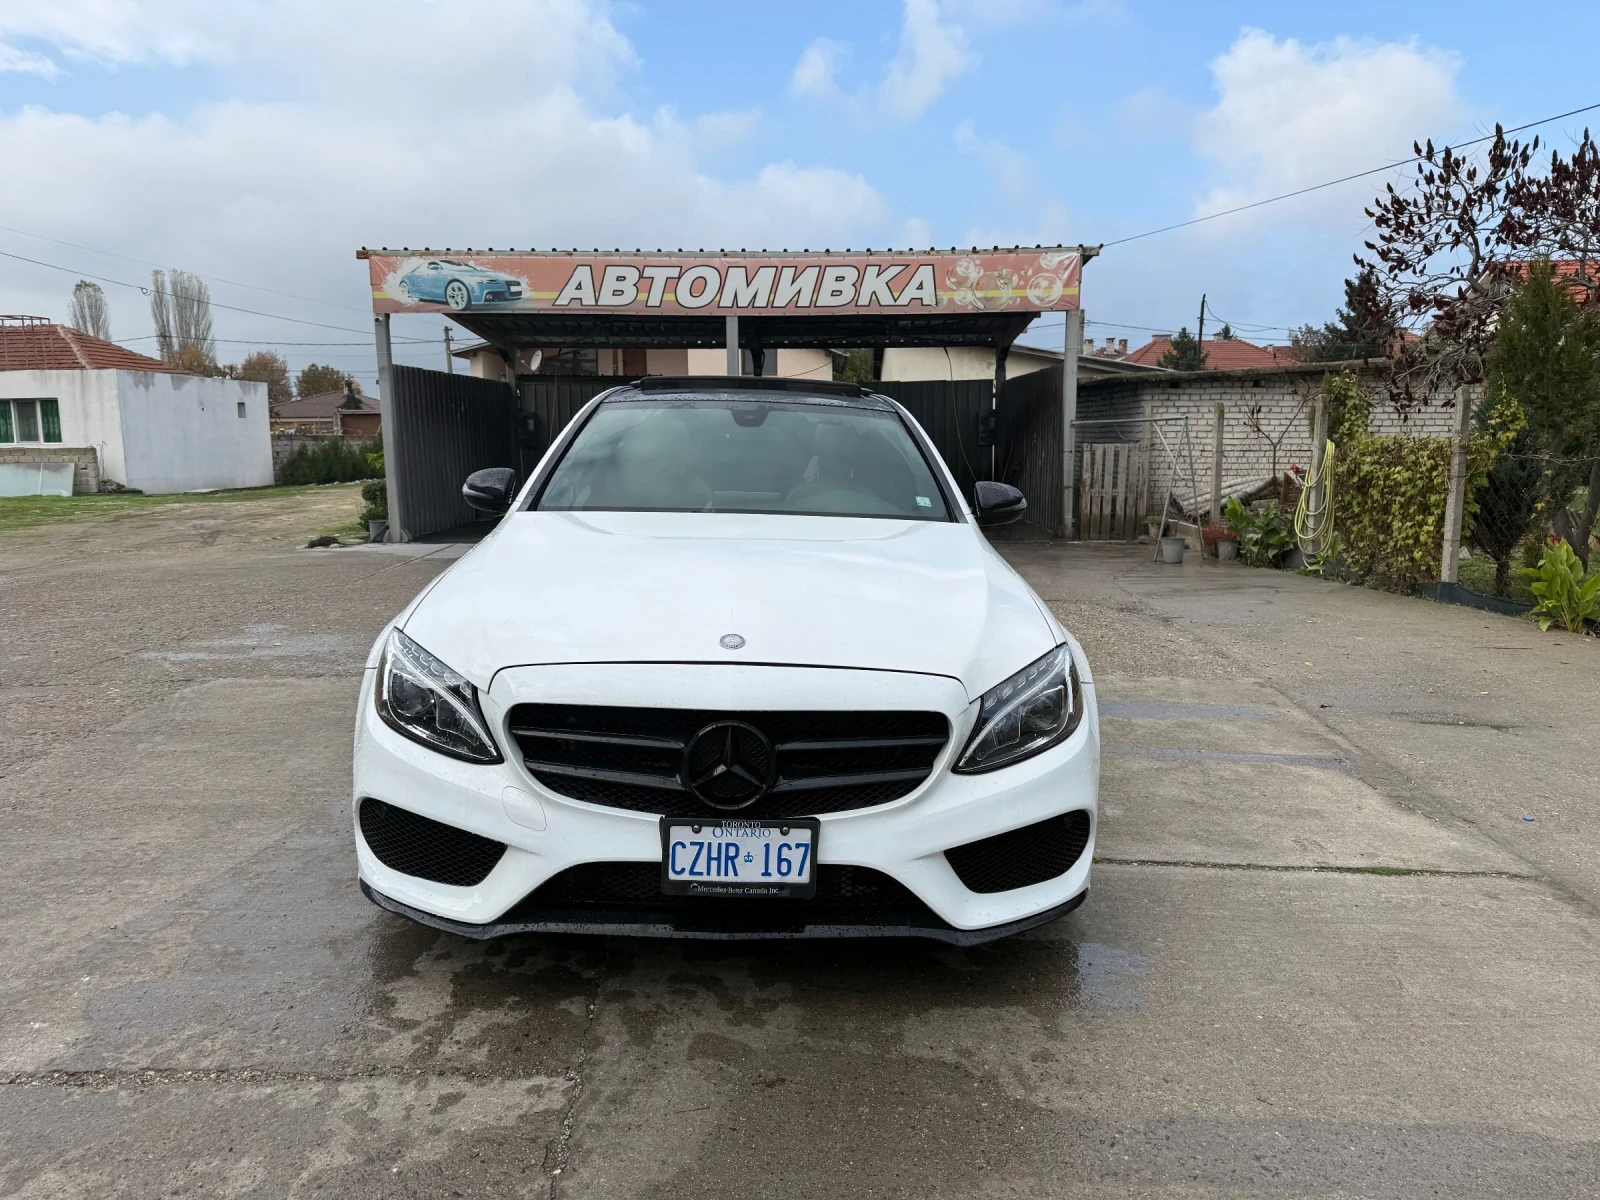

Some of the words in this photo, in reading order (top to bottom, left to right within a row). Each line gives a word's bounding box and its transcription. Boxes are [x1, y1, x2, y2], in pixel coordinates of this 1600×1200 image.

[552, 264, 938, 309] АВТОМИВКА
[721, 820, 761, 829] TORONTO
[712, 826, 772, 839] ONTARIO
[671, 840, 740, 877] CZHR
[761, 842, 810, 877] 167
[697, 885, 744, 895] Mercedes-Benz
[744, 887, 768, 895] Canada
[768, 887, 781, 895] Inc.
